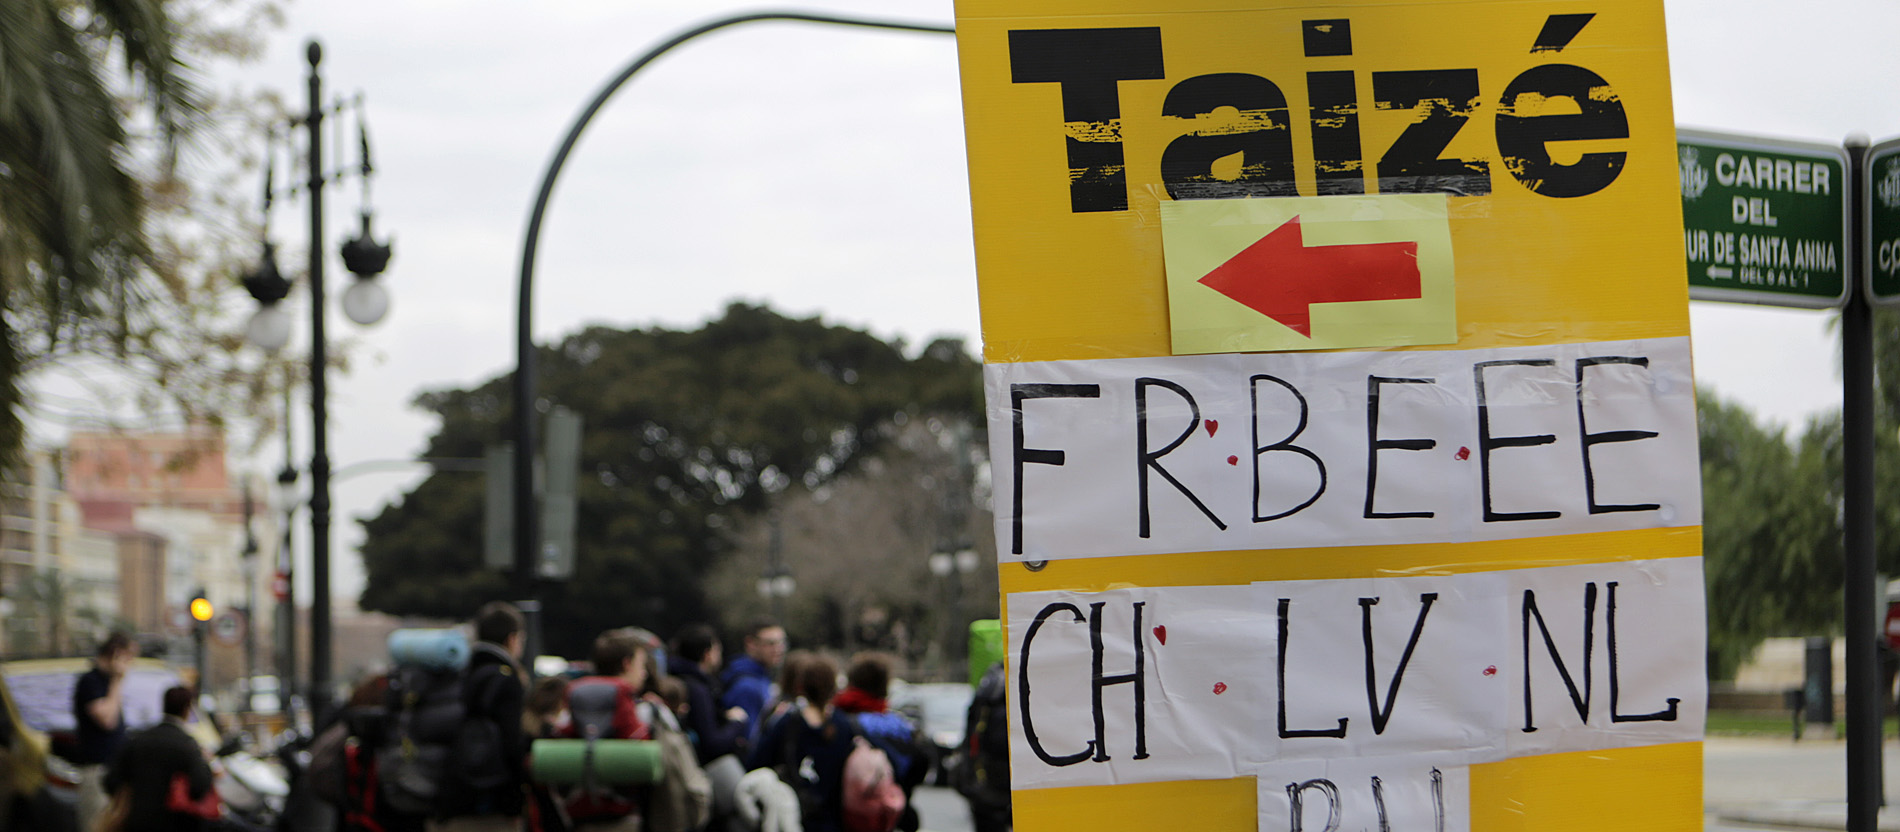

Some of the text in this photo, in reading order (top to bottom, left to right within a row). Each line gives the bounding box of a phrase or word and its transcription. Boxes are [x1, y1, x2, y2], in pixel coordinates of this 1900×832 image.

[1007, 13, 1630, 213] Taizé
[1714, 153, 1831, 195] CARRER
[1732, 195, 1778, 227] DEL
[1684, 229, 1836, 273] UR DE SANTA ANNA
[1740, 265, 1764, 285] DEL
[1019, 582, 1681, 767] CH LV NL
